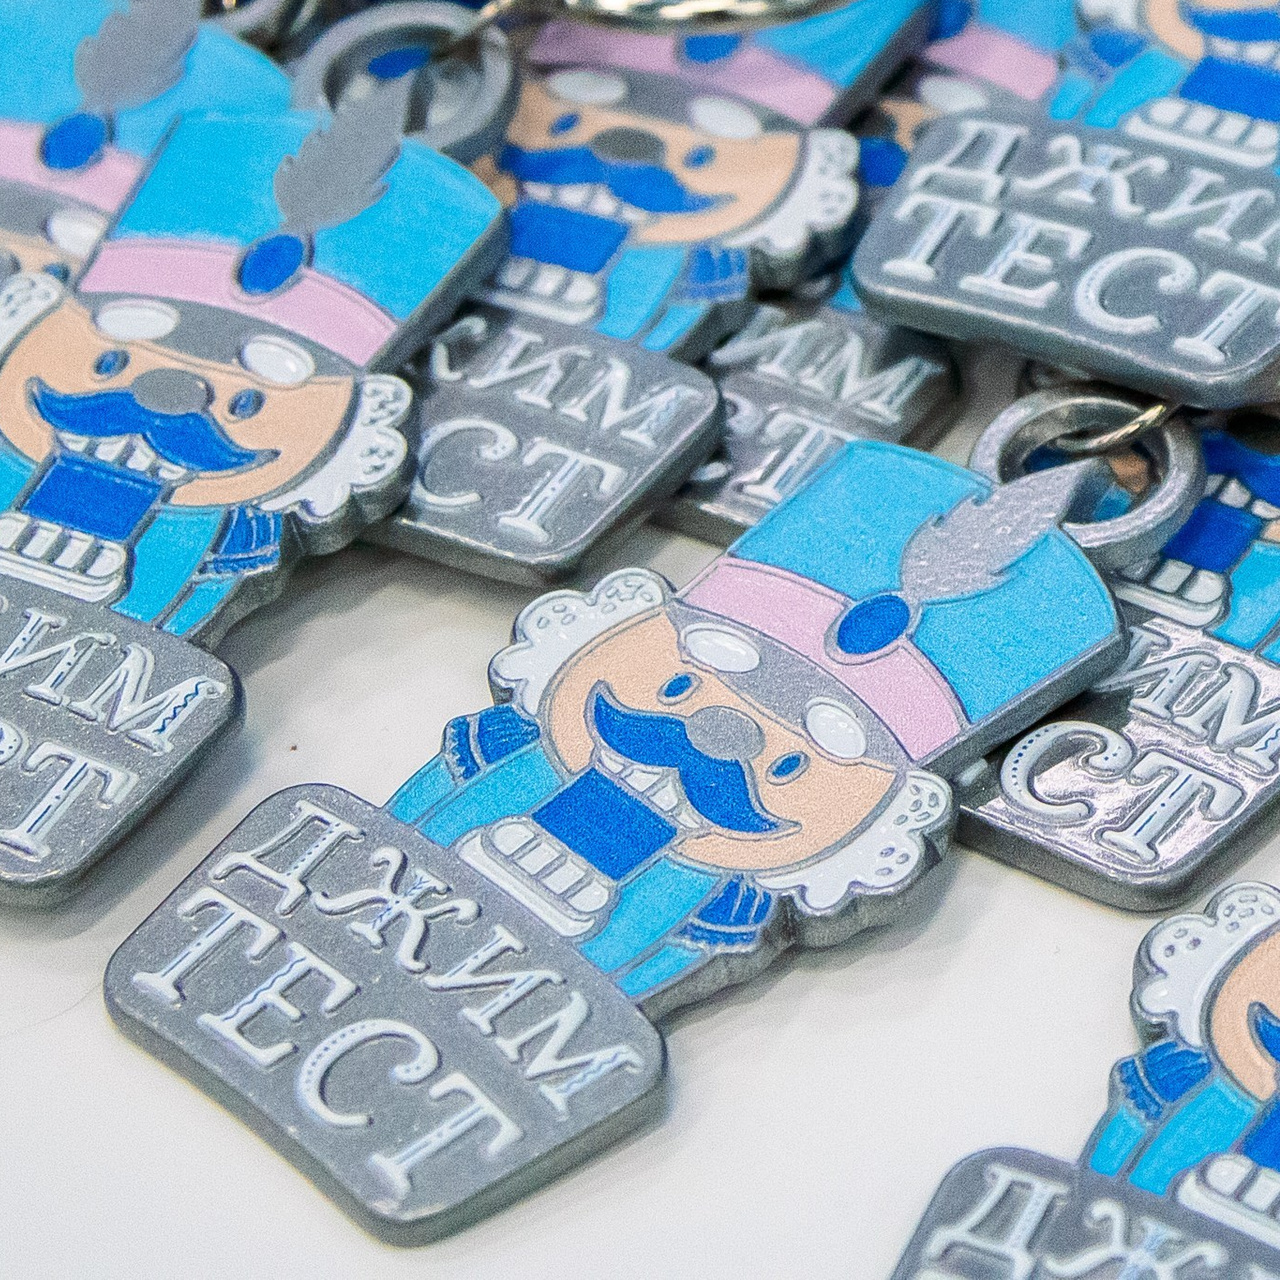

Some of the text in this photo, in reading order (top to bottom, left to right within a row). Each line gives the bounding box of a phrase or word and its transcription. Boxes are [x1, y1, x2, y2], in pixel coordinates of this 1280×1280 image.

[0, 595, 226, 756] ИМ
[957, 721, 1246, 863] СТ
[133, 887, 524, 1198] ТЕСТ
[215, 800, 642, 1116] ДЖИМ
